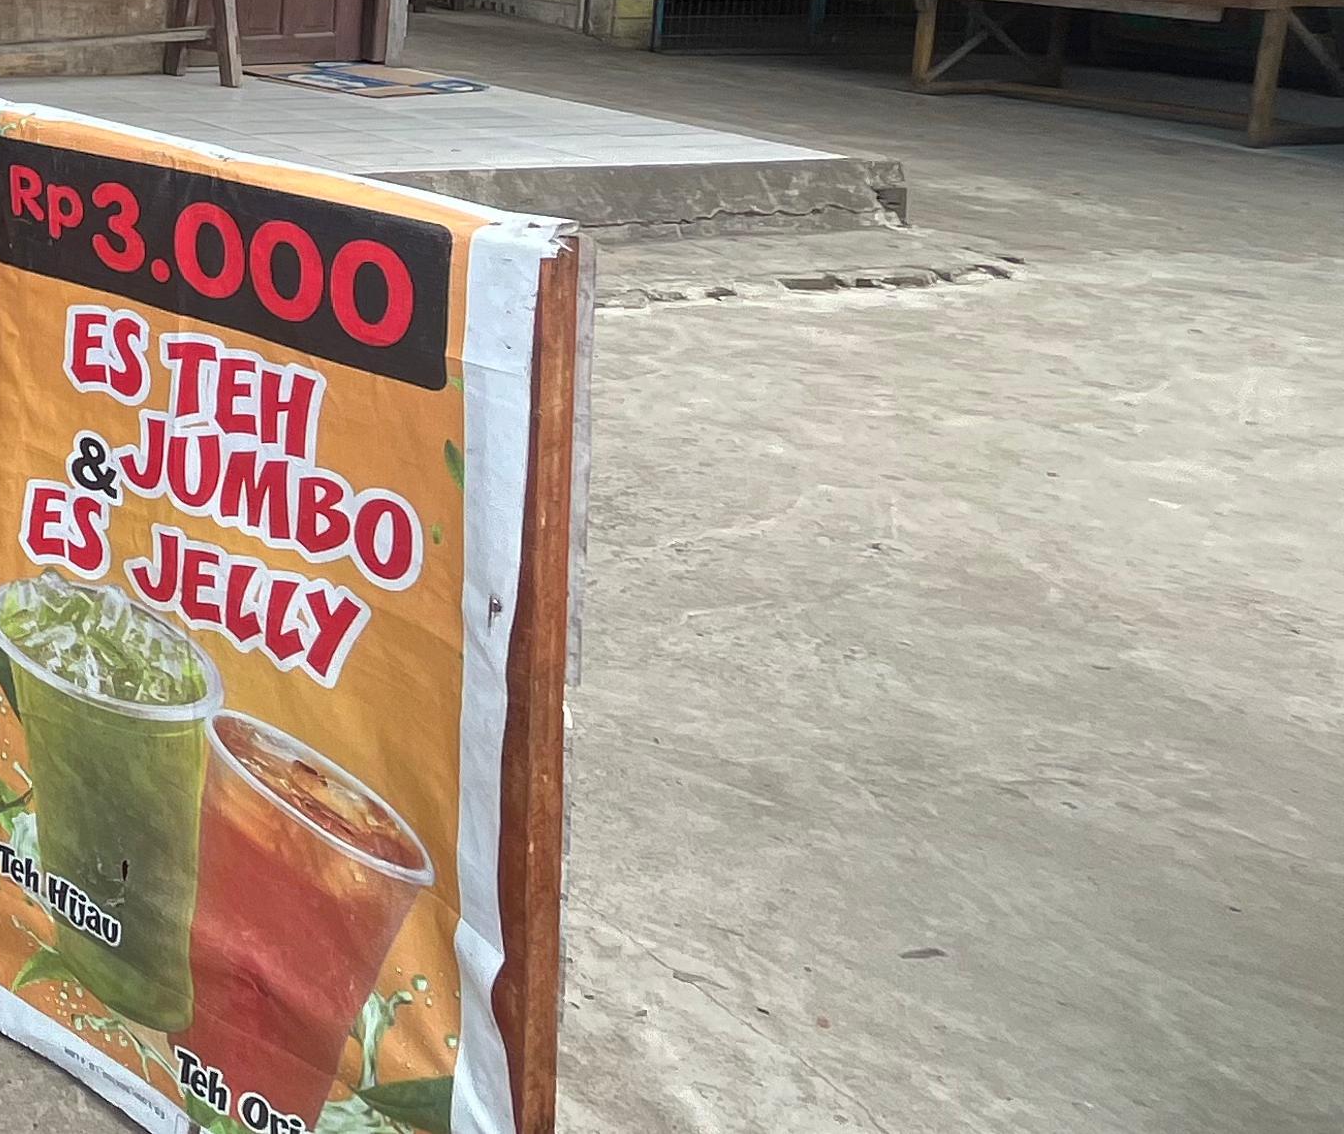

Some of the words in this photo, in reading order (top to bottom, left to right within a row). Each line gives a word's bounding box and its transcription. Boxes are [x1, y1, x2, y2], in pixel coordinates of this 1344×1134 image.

[68, 310, 144, 400] ES
[167, 340, 318, 458] TEH
[71, 436, 119, 499] &
[118, 418, 414, 582] JUMBO
[27, 486, 109, 573] ES
[130, 532, 363, 678] JELLY
[47, 875, 120, 944] Hijau
[176, 1046, 228, 1113] Teh
